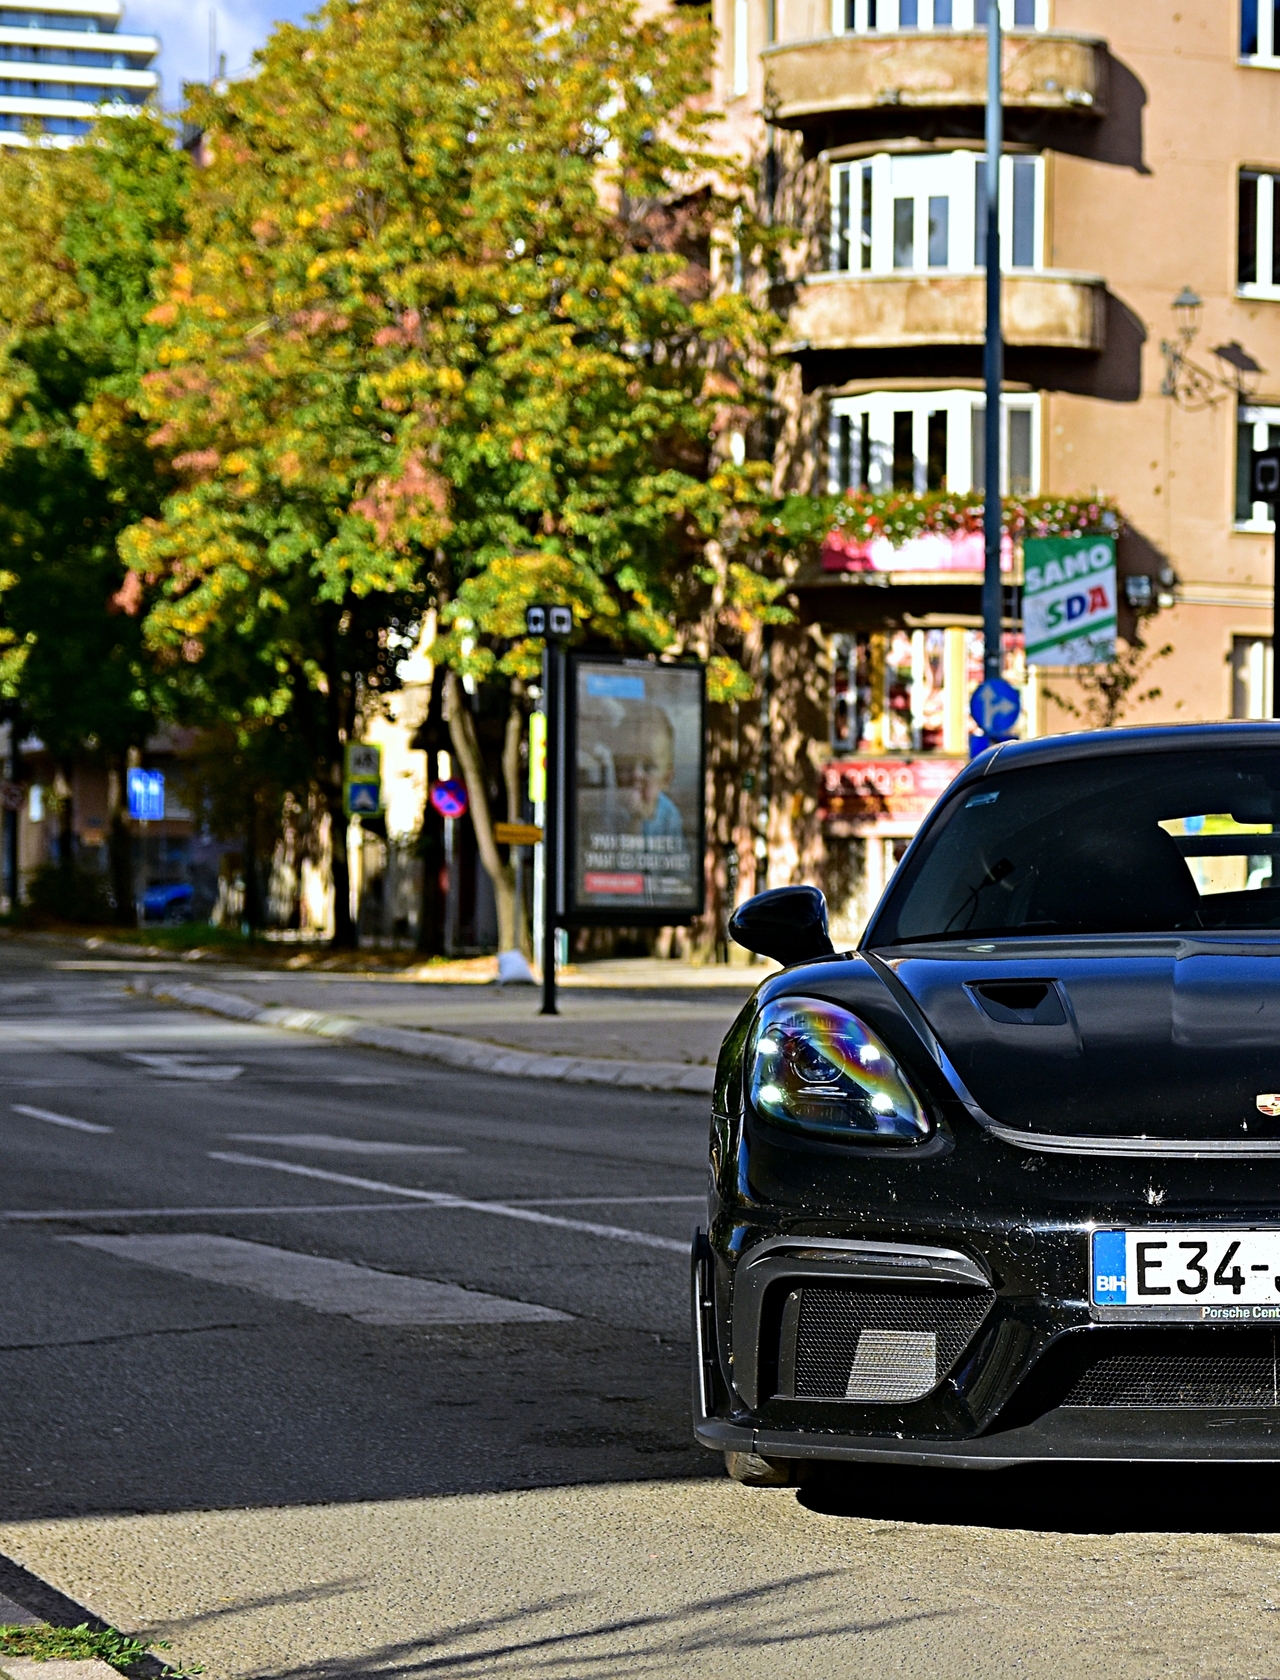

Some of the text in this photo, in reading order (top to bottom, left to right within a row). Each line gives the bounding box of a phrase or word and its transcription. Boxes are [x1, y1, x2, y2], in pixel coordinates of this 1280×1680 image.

[1026, 544, 1113, 592] SAMO
[1046, 585, 1110, 629] SDA
[1096, 1275, 1127, 1292] BIH
[1202, 1306, 1250, 1319] Porsche
